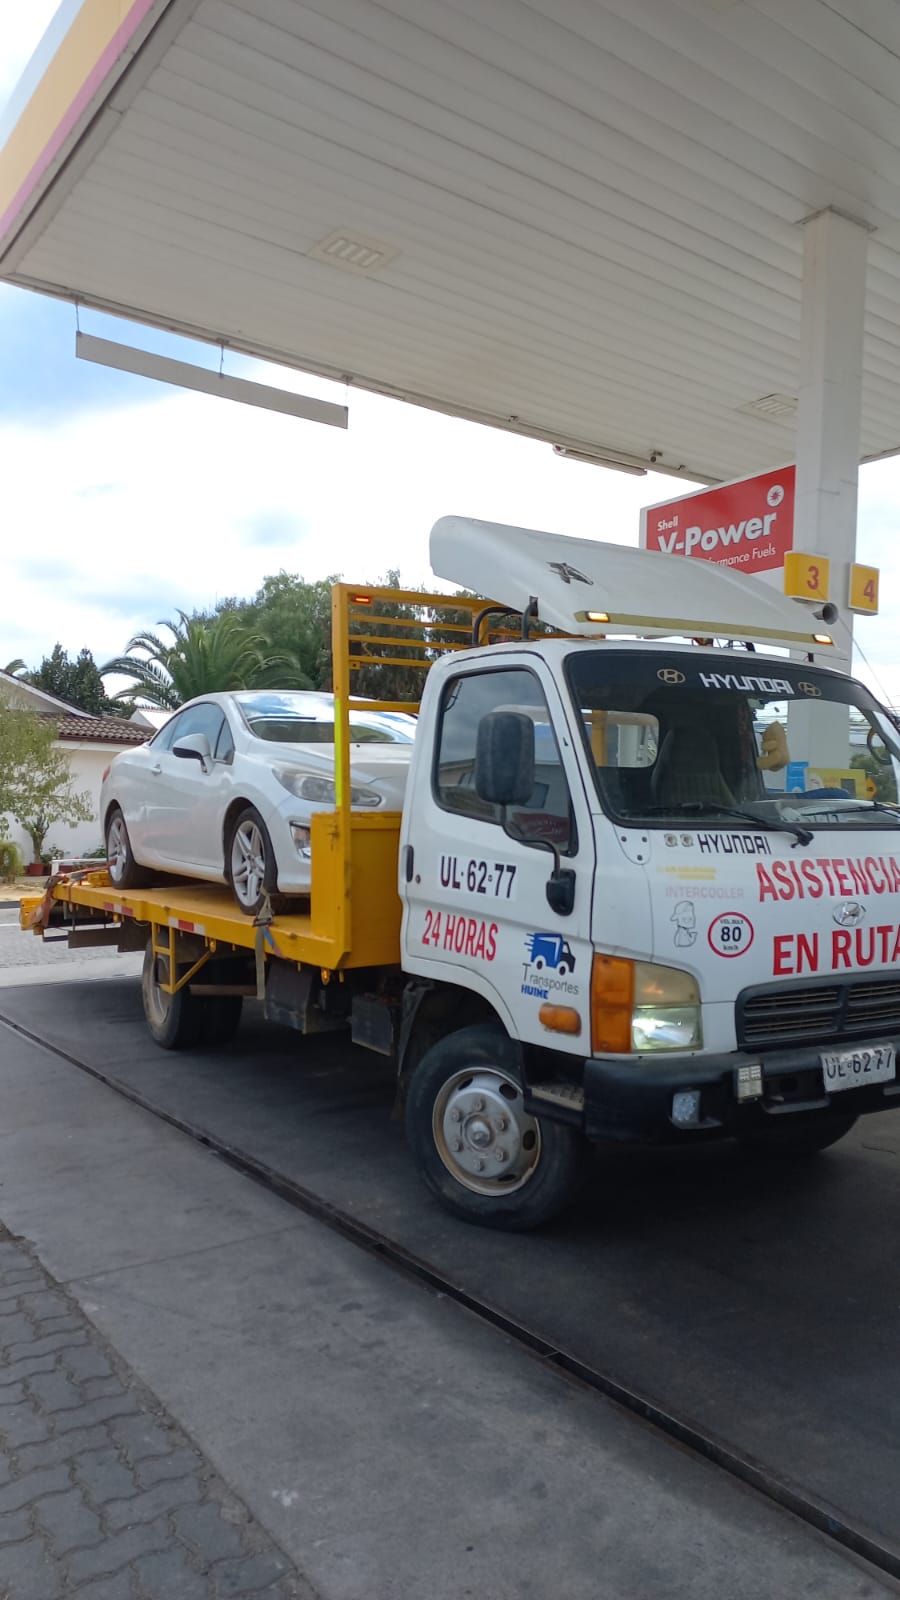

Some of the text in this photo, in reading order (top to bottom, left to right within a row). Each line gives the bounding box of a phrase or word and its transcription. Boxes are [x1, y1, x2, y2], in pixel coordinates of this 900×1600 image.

[657, 514, 678, 531] Shell
[657, 511, 777, 556] V-Power
[752, 542, 776, 560] Fuels
[807, 566, 820, 590] 3
[863, 579, 875, 603] 4
[699, 672, 794, 695] HYUNDAI
[696, 833, 771, 855] HYUNDAI
[756, 856, 900, 902] ASISTENCIA
[665, 886, 744, 899] INTERCOOLER
[421, 909, 499, 961] 24 HORAS
[720, 926, 742, 942] 80
[773, 933, 819, 976] EN
[522, 962, 579, 995] Transportes
